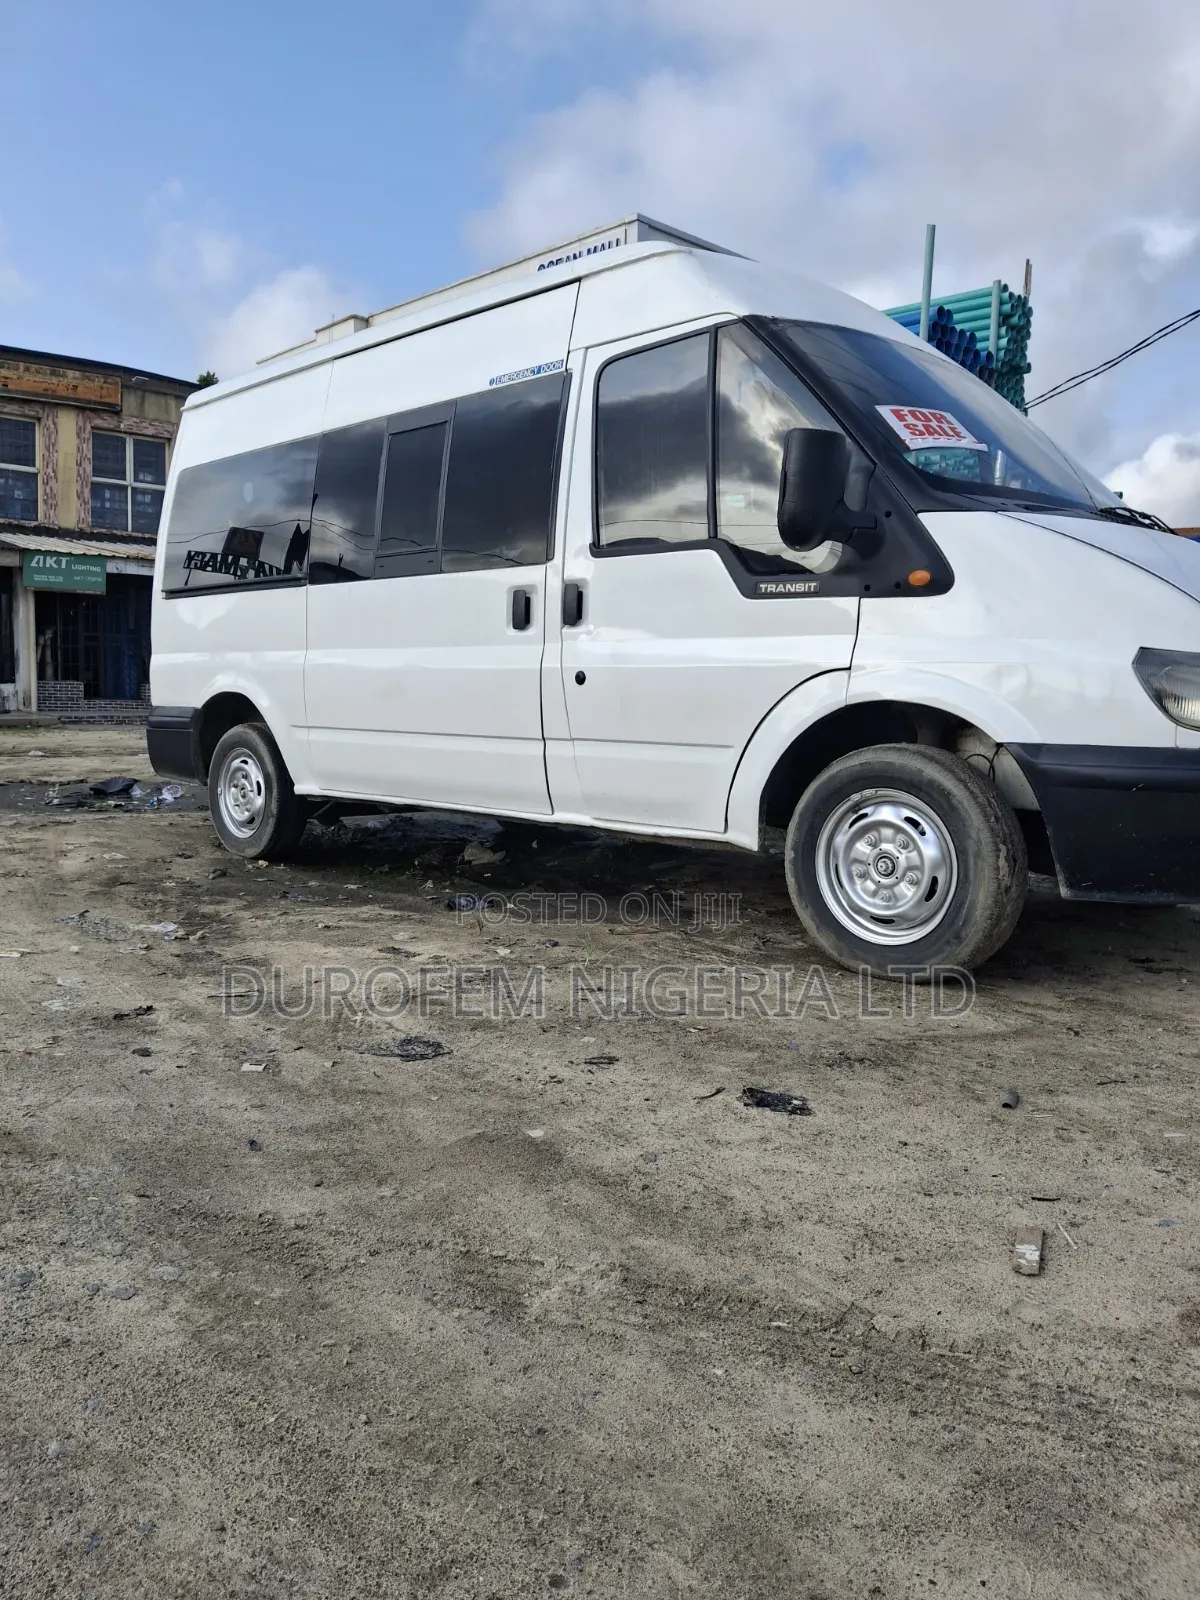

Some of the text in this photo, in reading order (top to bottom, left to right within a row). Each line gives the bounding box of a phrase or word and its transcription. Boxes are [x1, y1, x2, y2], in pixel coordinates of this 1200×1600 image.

[496, 360, 563, 385] EMERGENCY DOOR
[889, 408, 955, 426] FOR
[903, 422, 967, 439] SALE
[30, 555, 70, 569] AKT
[71, 563, 101, 572] LIGHTING
[759, 582, 818, 593] TRANSIT
